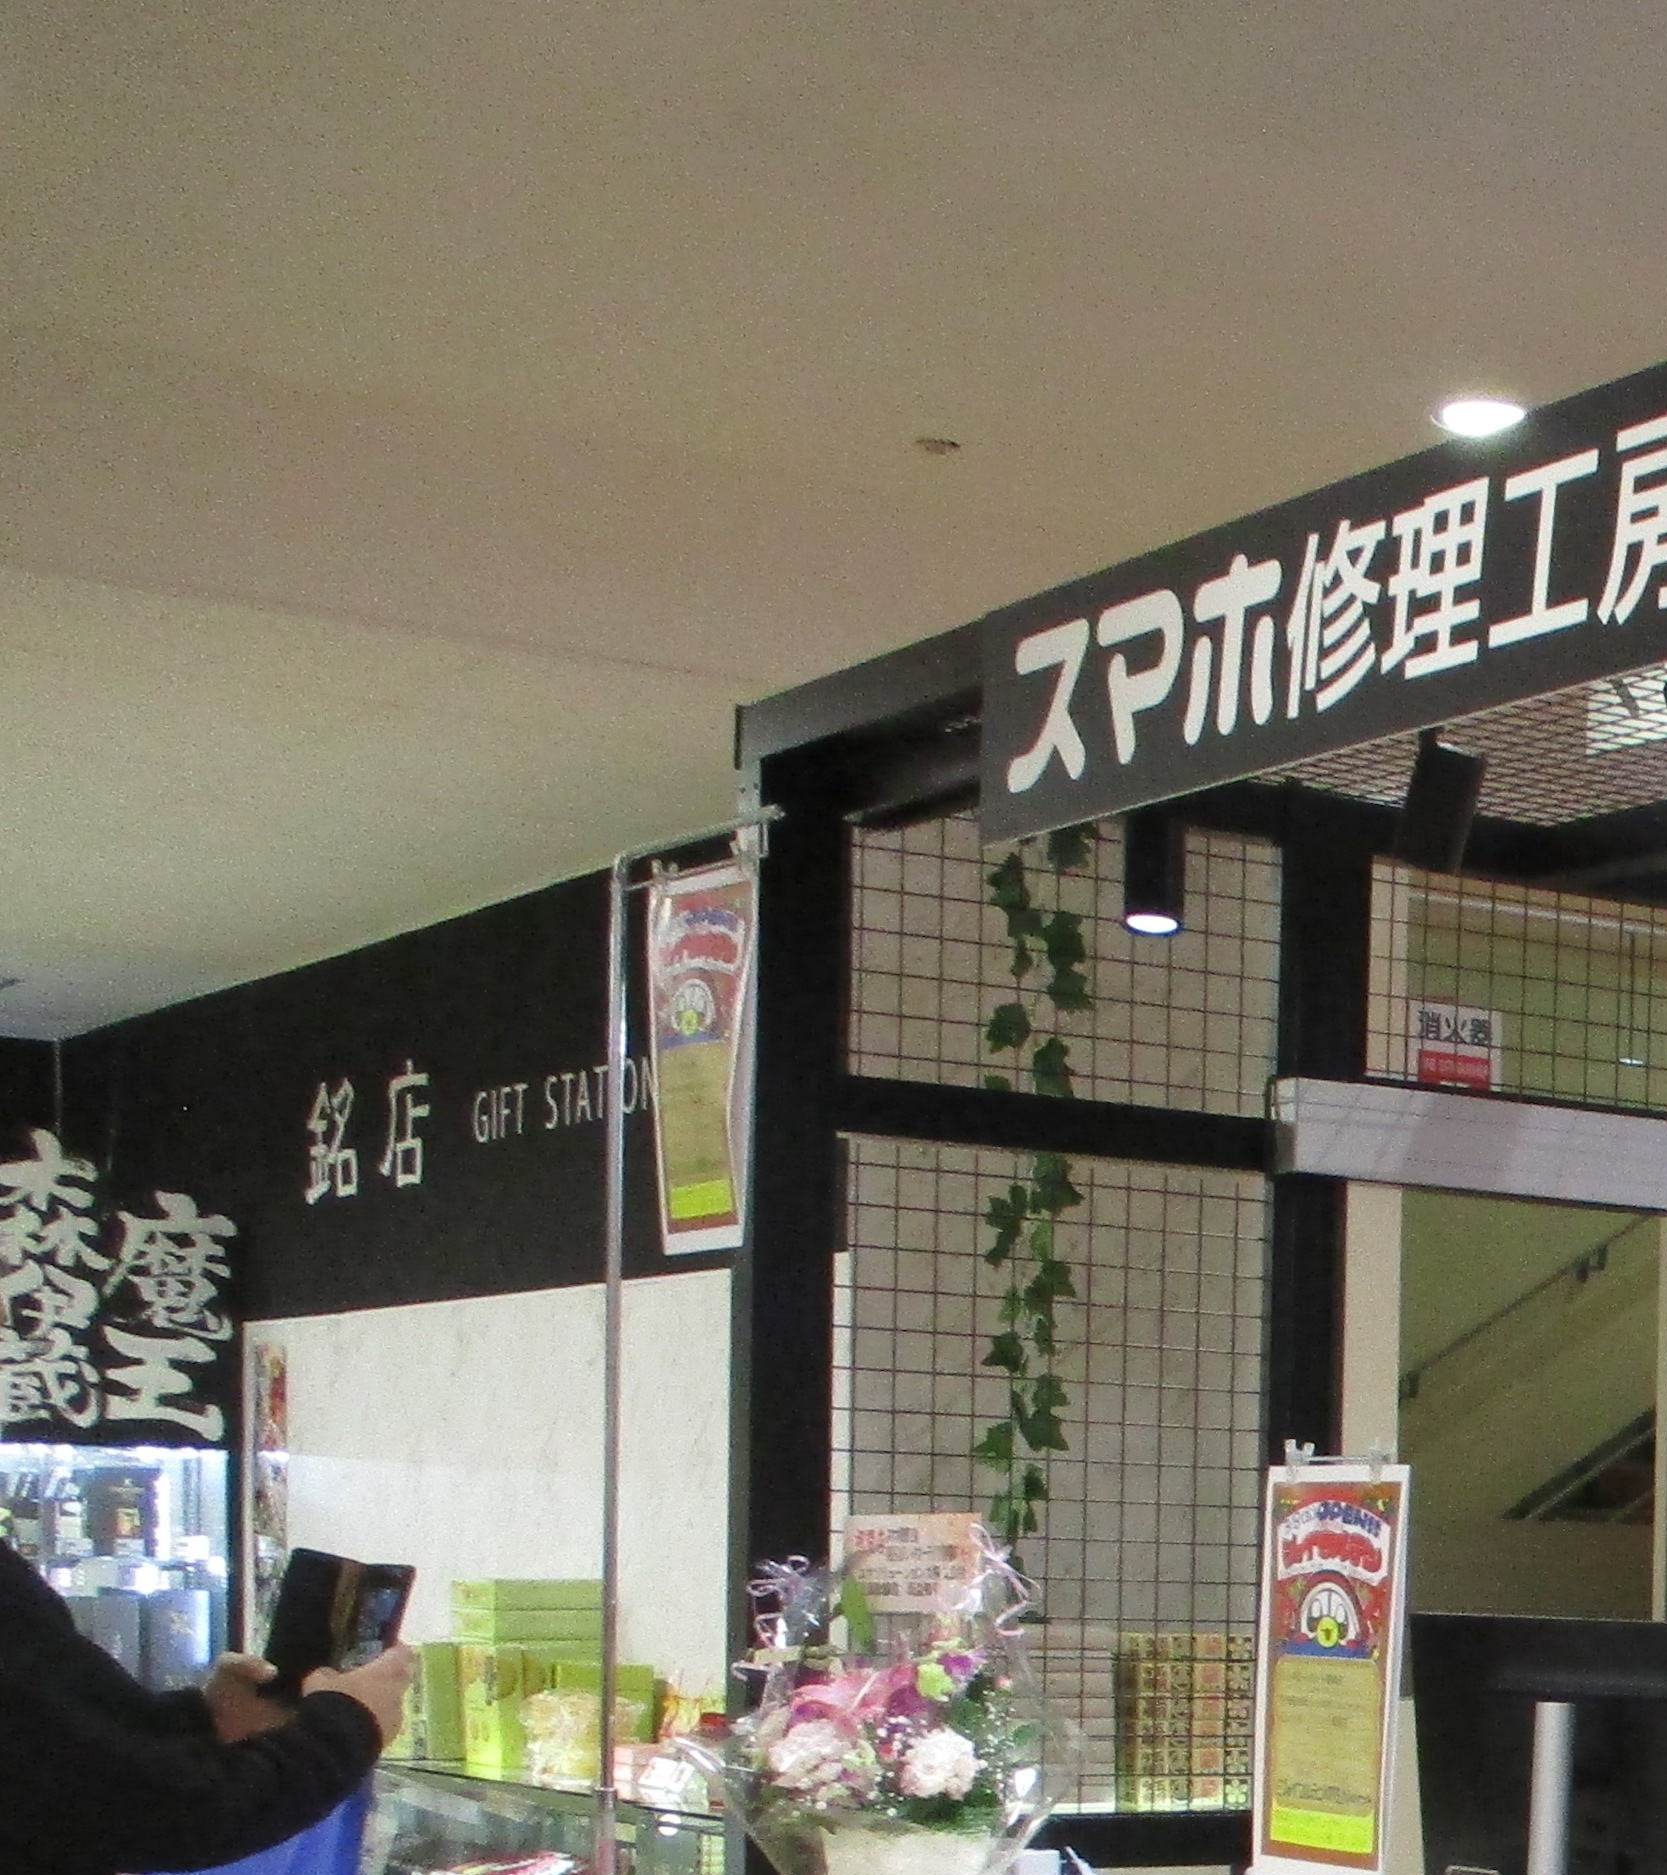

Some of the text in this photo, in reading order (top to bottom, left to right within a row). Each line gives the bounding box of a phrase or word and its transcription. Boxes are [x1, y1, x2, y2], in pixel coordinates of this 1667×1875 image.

[473, 1056, 652, 1143] GIFT STATON
[102, 1191, 240, 1441] 魔王
